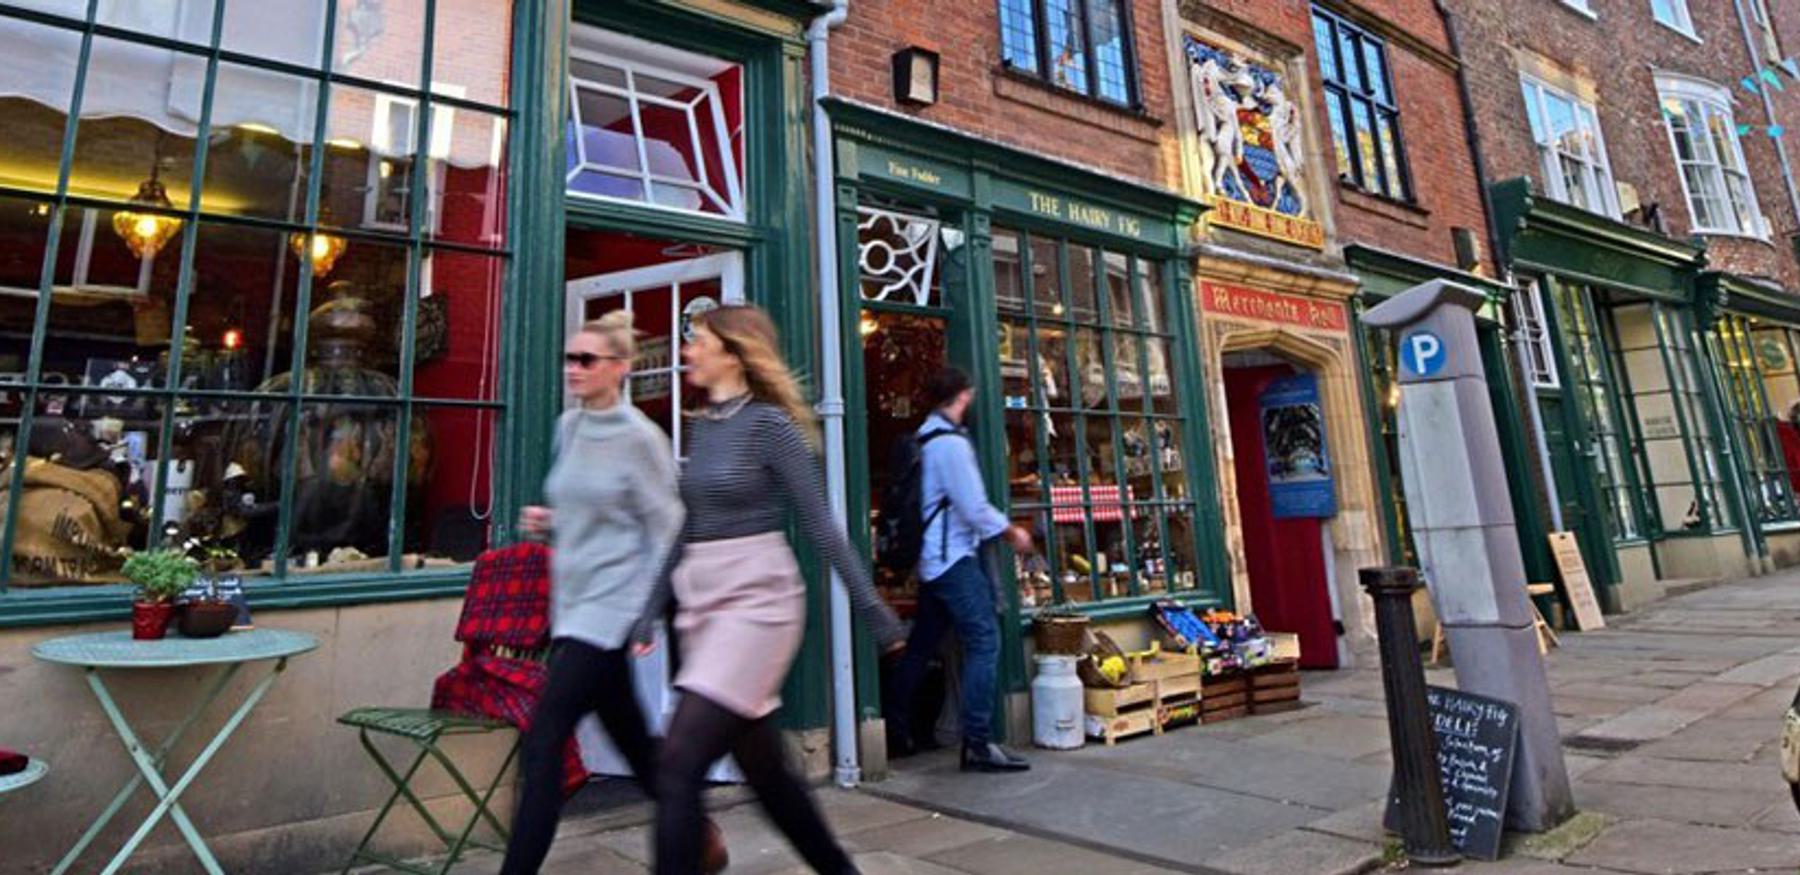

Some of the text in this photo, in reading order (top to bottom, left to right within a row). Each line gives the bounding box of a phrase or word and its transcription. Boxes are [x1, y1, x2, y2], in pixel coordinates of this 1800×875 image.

[1027, 191, 1141, 238] THE HAIRY FIG
[1212, 285, 1300, 322] Merchants
[1411, 335, 1440, 375] P
